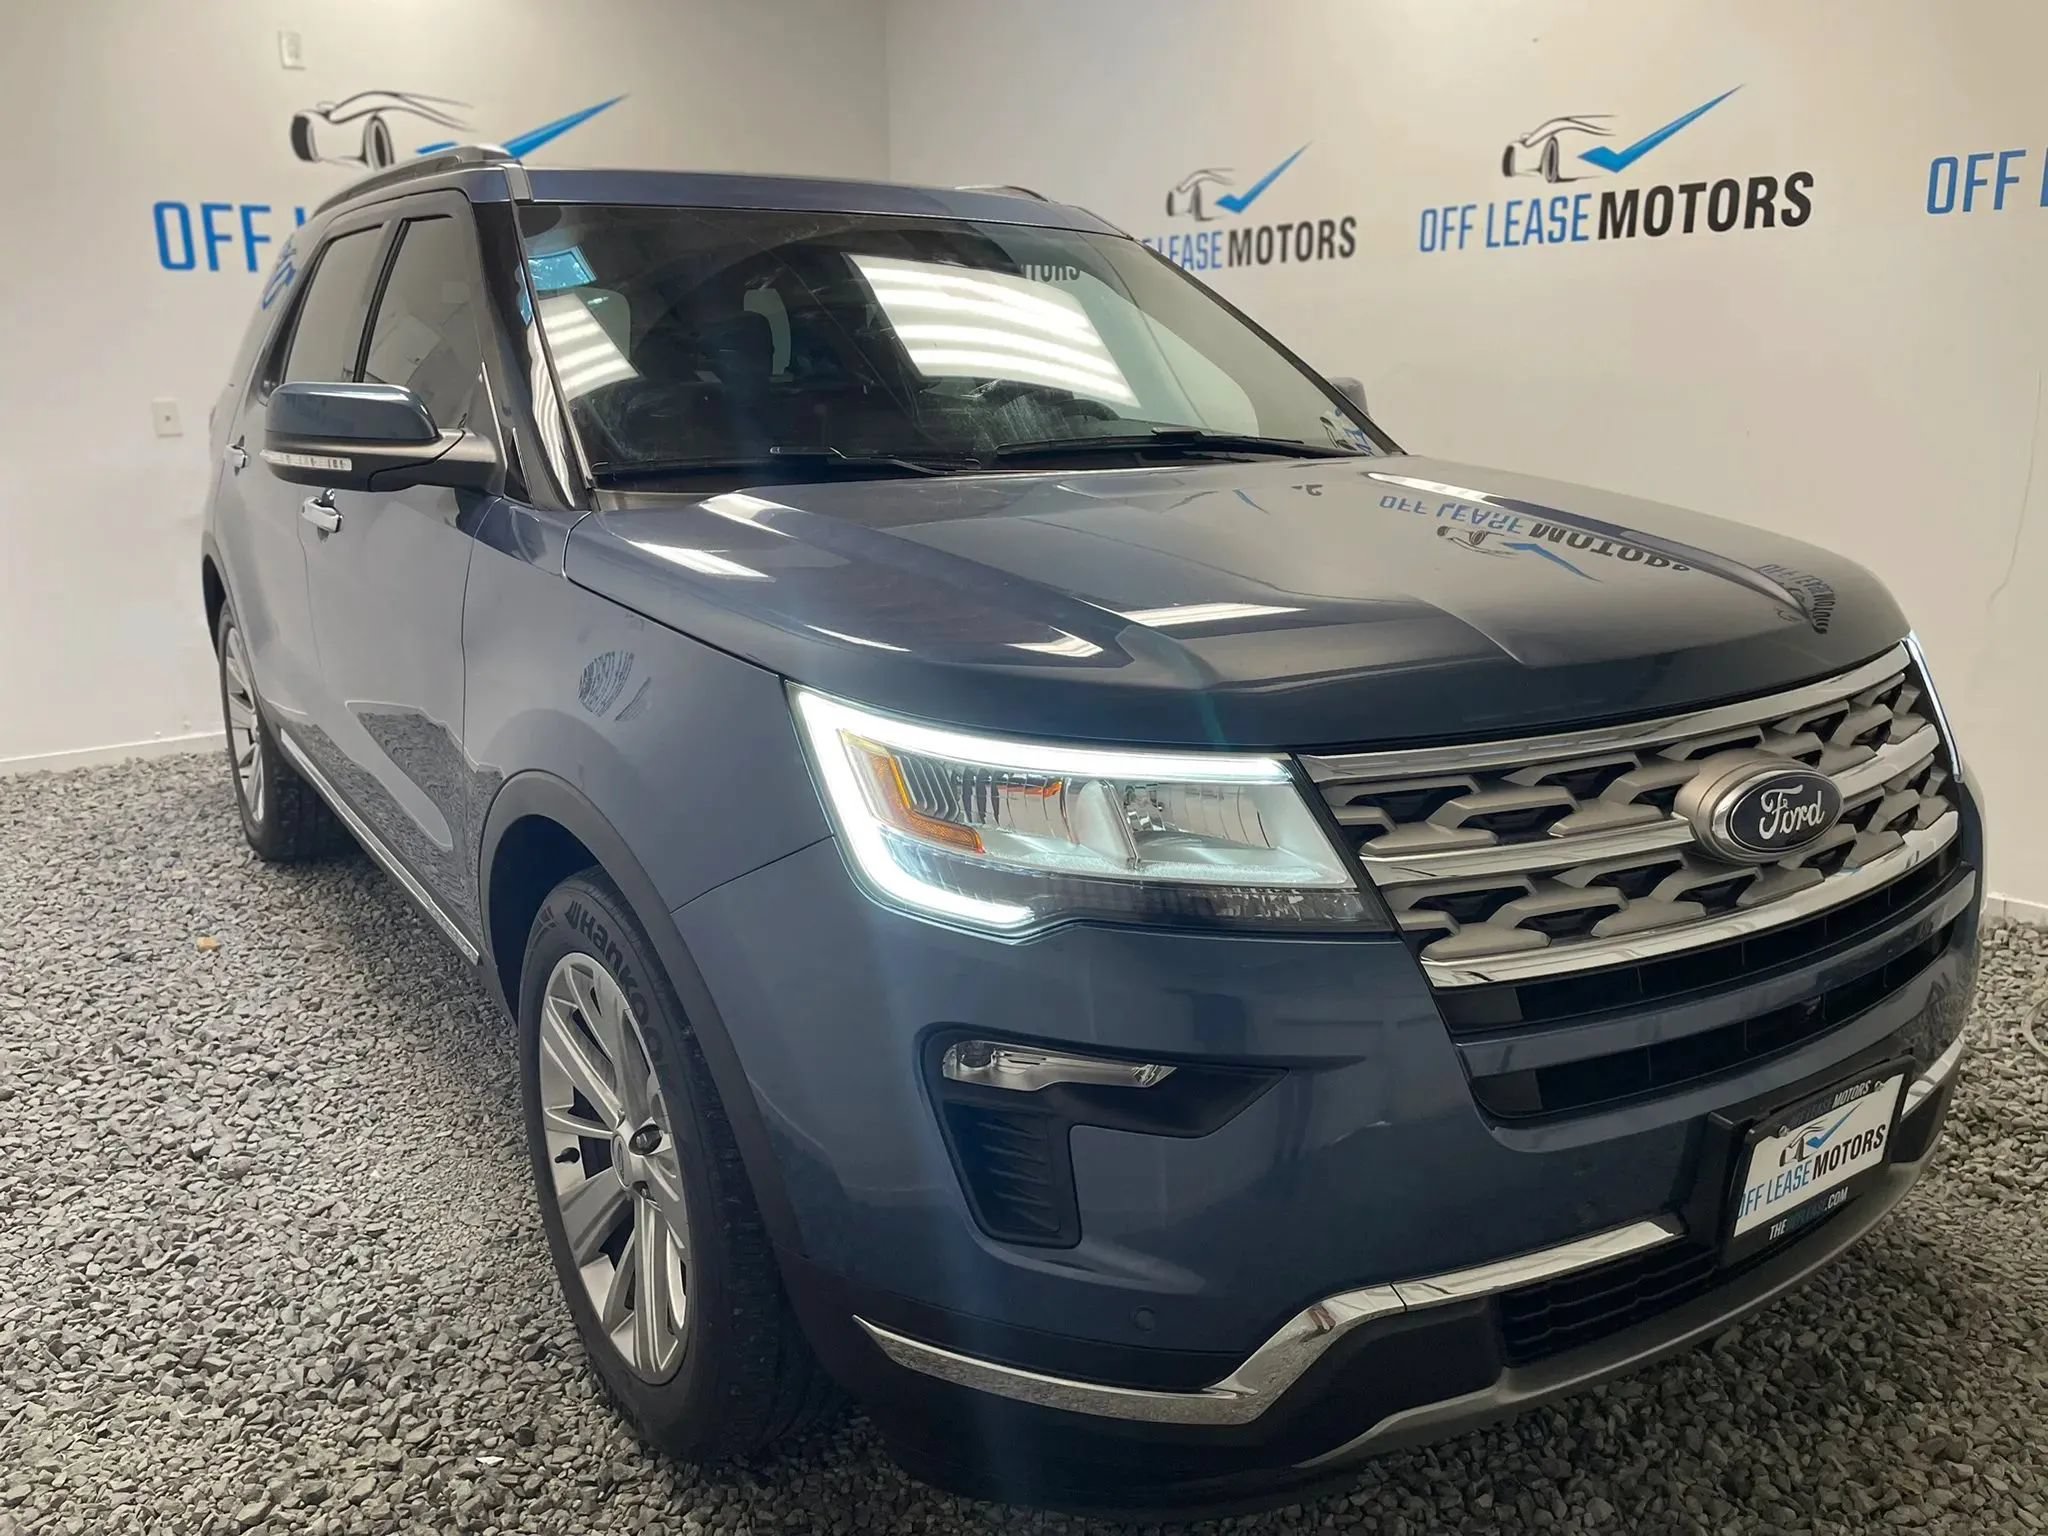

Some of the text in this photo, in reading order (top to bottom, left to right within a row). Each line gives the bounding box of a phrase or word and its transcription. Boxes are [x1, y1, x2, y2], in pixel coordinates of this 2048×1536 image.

[1419, 171, 1814, 252] OFF LEASE MOTORS
[1927, 149, 2027, 214] OFF
[153, 201, 271, 272] OFF
[1228, 216, 1357, 268] MOTORS
[1758, 784, 1826, 840] Ford
[579, 907, 664, 1061] Hankoo
[1831, 1079, 1871, 1109] MOTORS
[1766, 1160, 1812, 1204] LEASE
[1812, 1123, 1886, 1180] MOTORS
[1769, 1218, 1788, 1241] THE
